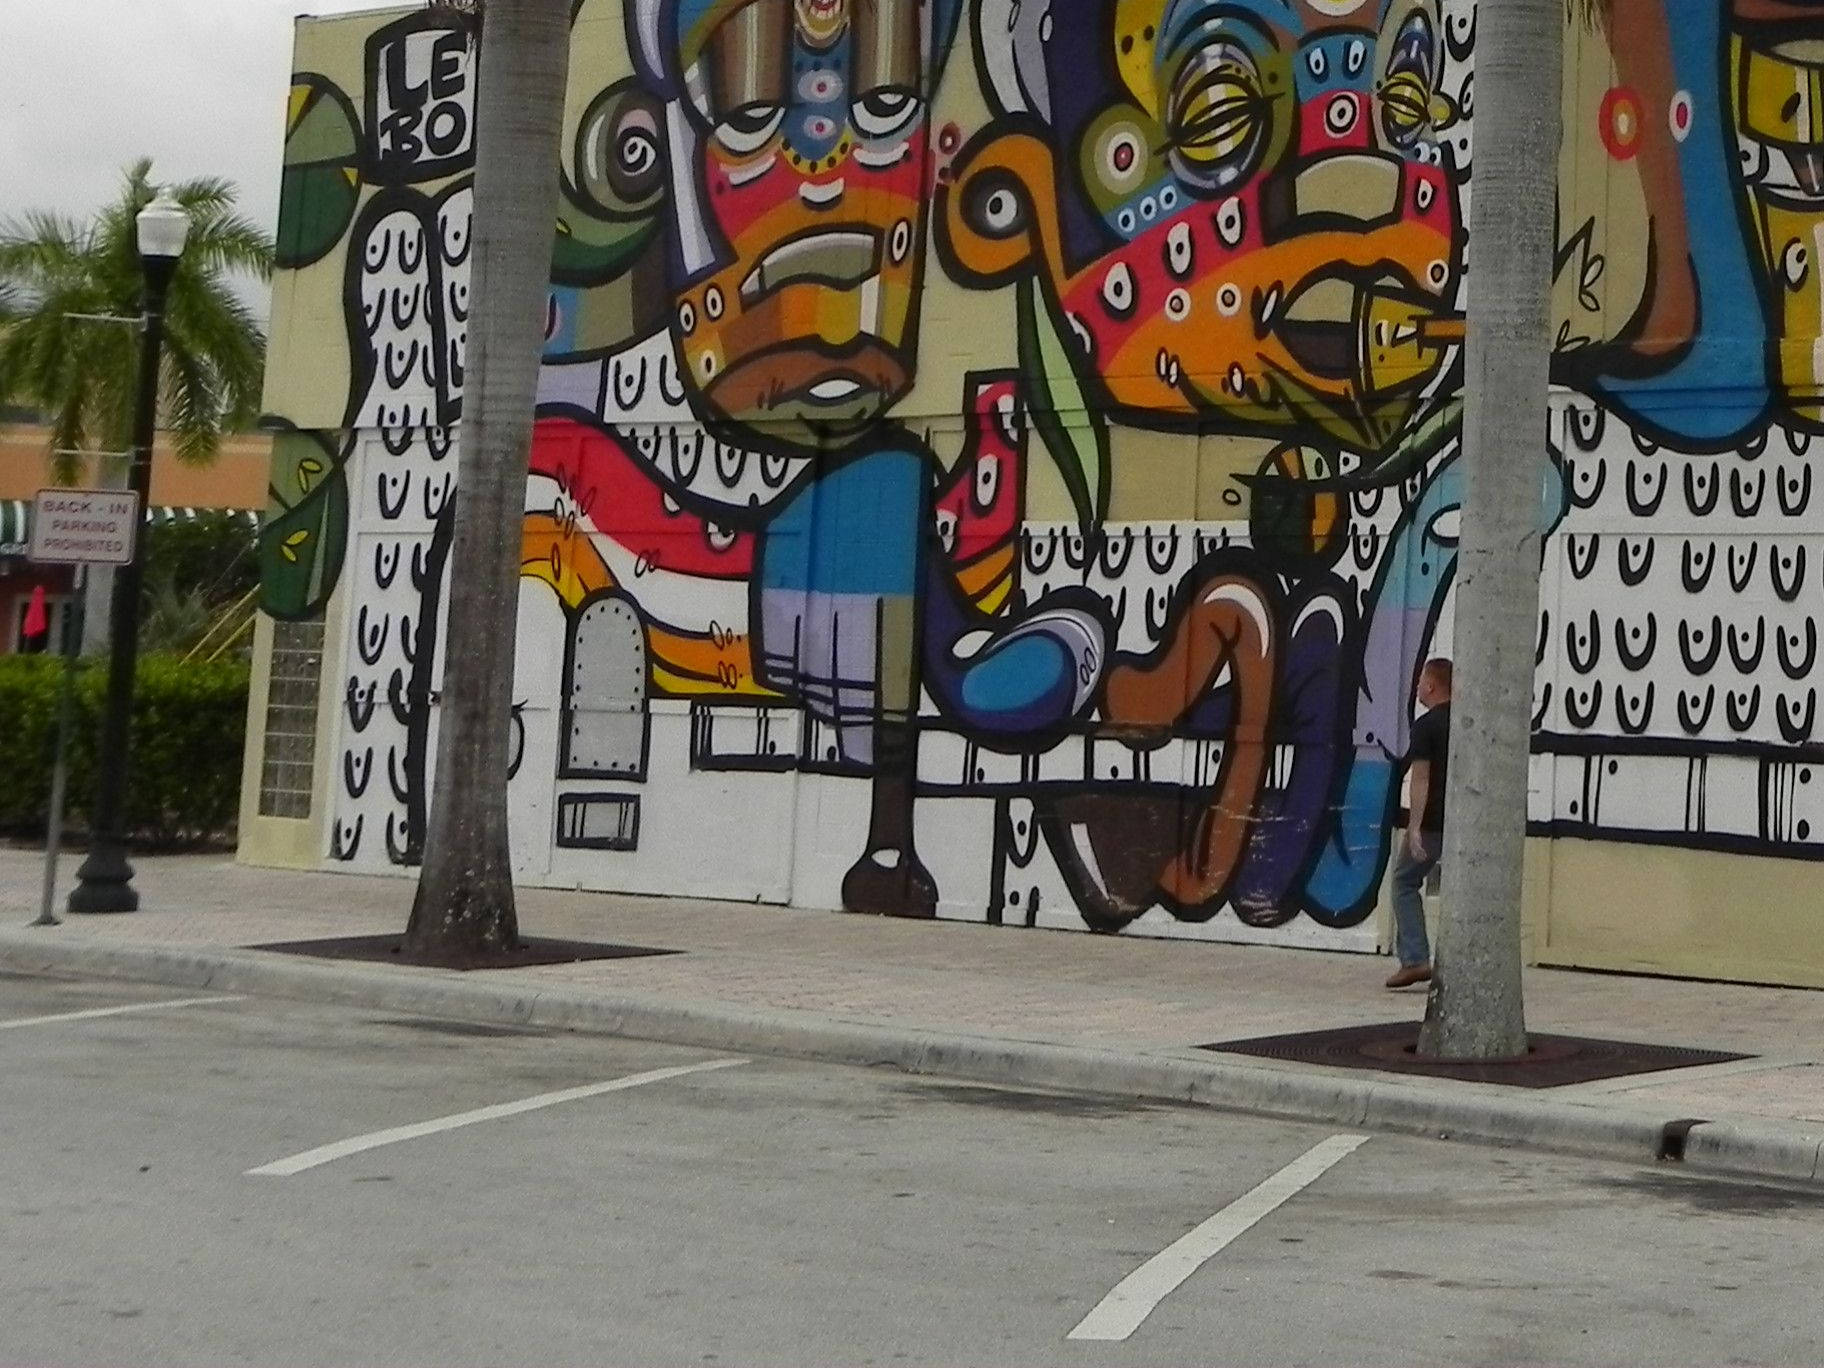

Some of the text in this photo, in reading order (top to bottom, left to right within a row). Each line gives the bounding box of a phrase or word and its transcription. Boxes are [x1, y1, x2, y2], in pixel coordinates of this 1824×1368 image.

[386, 29, 467, 110] LE
[380, 101, 467, 162] BO
[43, 500, 92, 513] BACK
[110, 503, 128, 514] IN
[52, 519, 118, 533] PARKING
[43, 538, 123, 552] PROHIBITED
